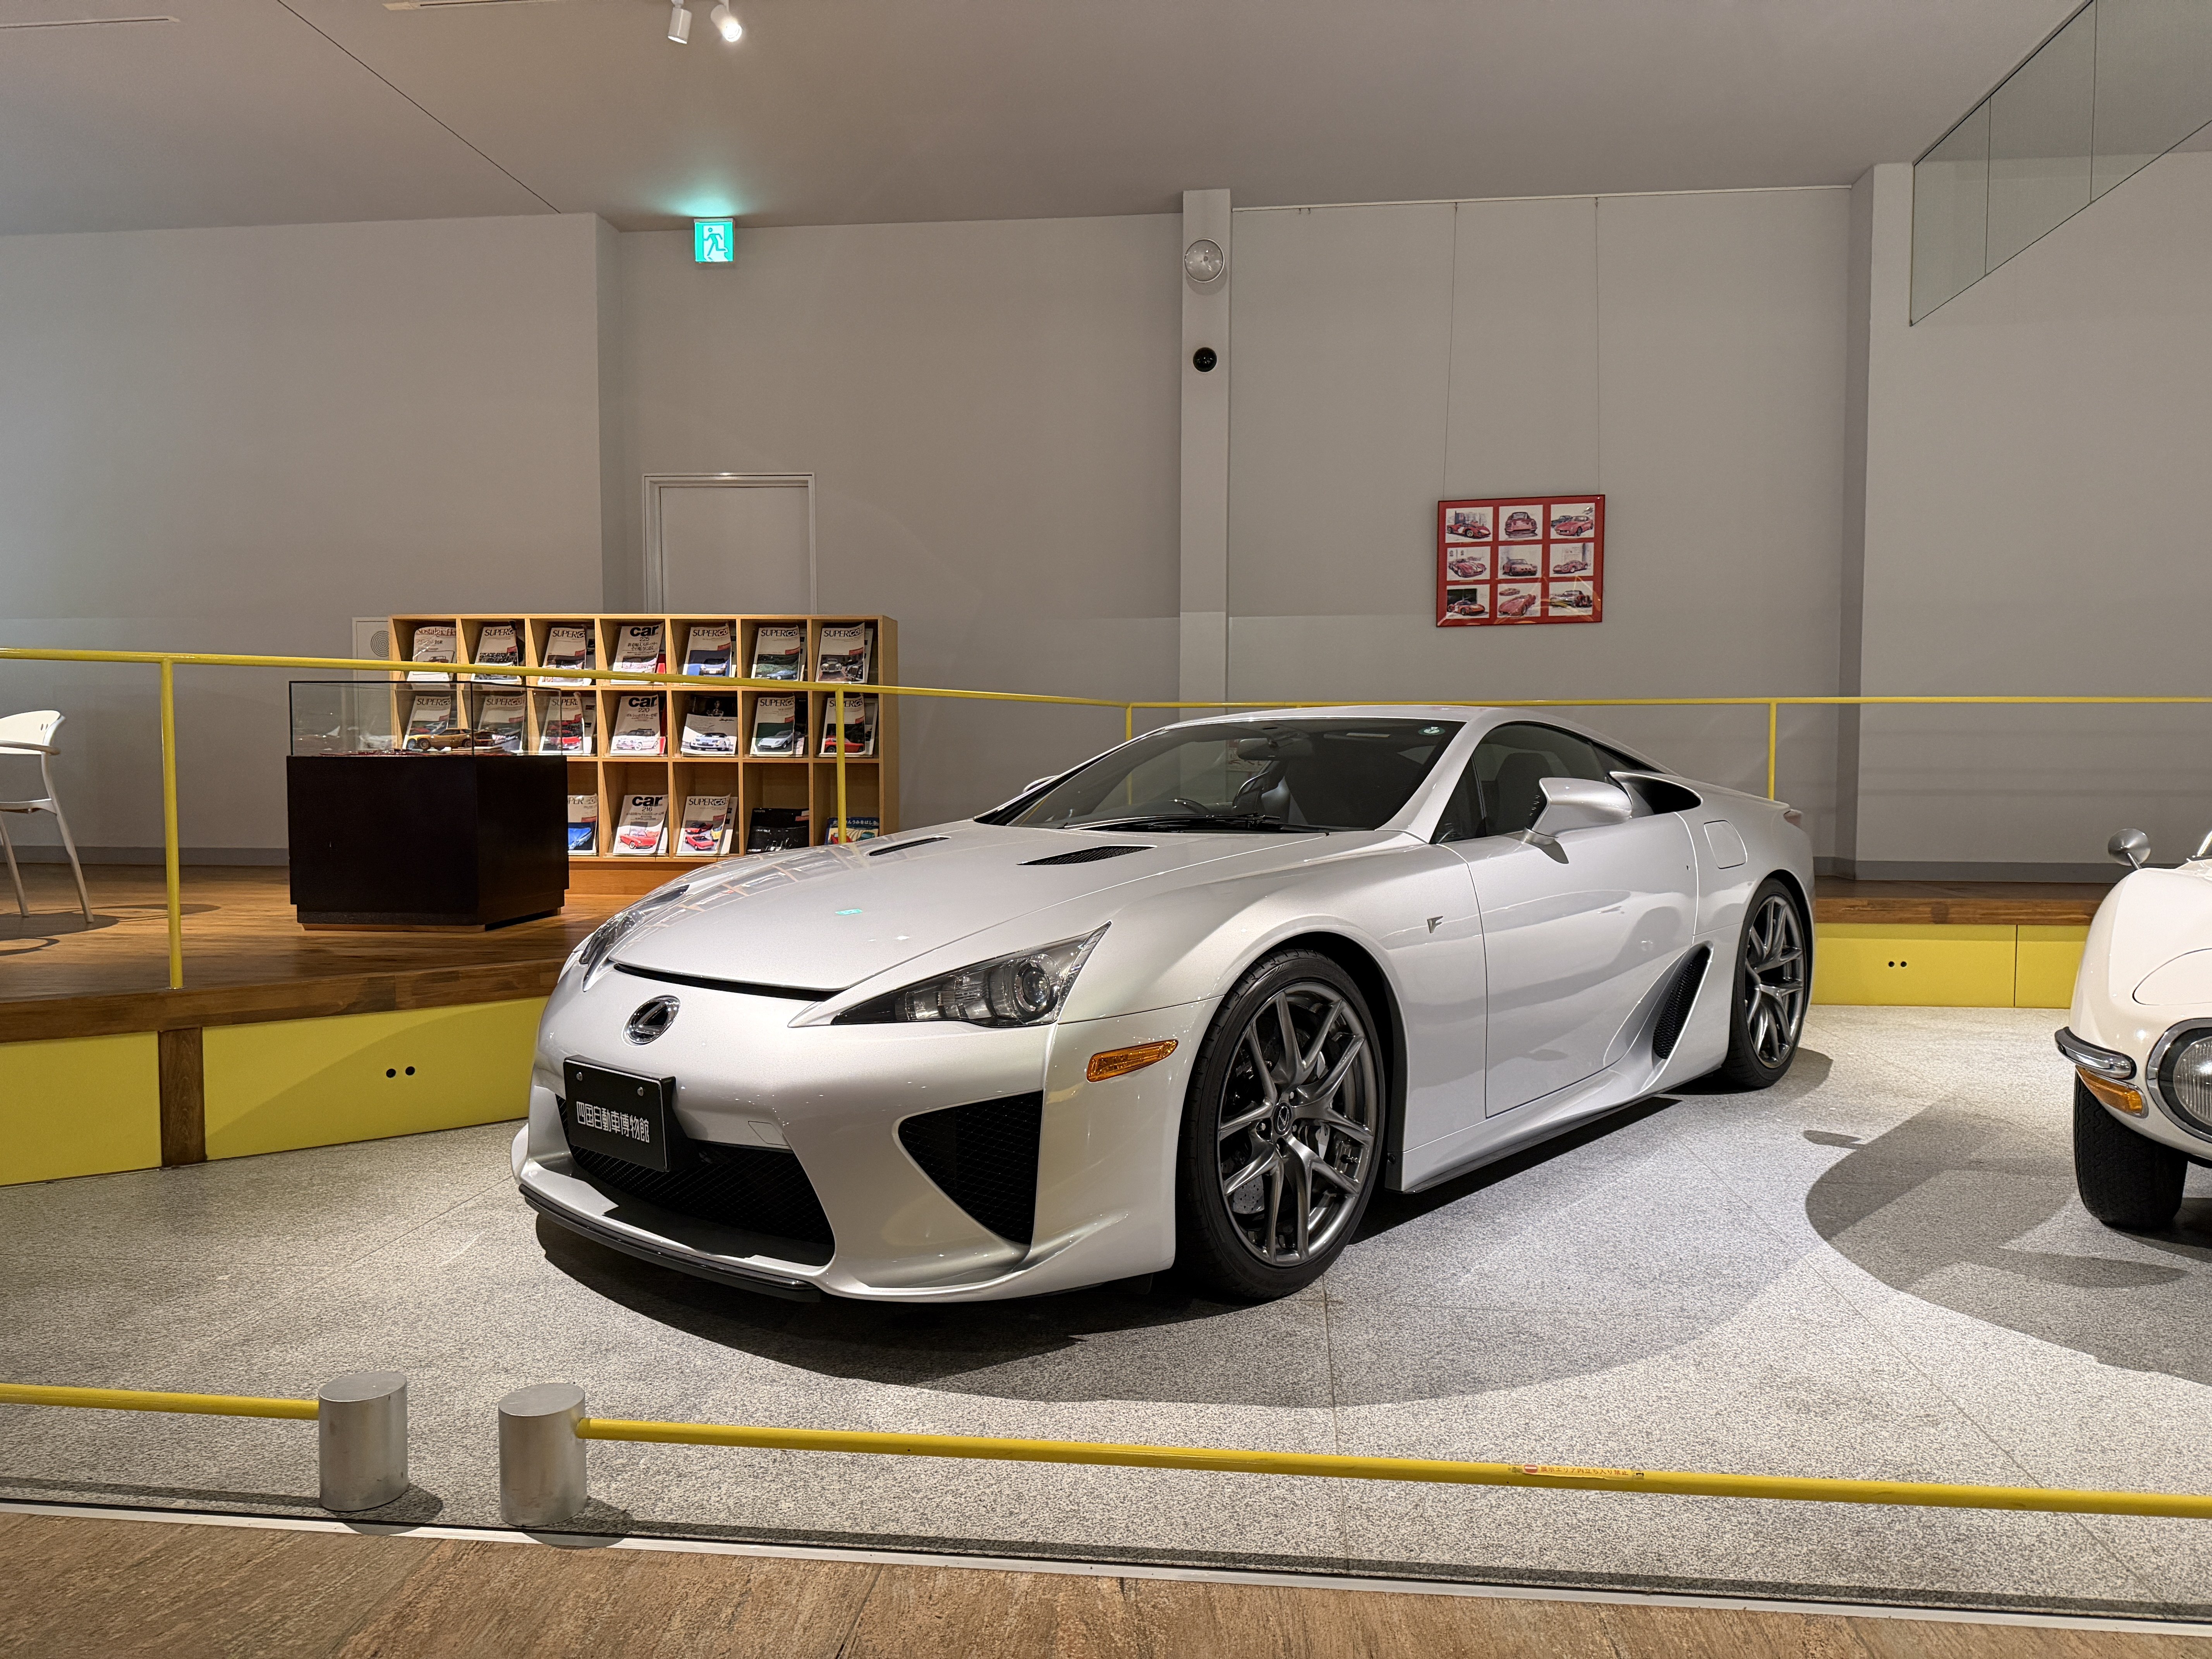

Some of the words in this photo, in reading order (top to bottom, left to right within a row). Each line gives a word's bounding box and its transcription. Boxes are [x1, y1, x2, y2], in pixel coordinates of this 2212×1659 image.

[630, 626, 659, 636] car
[628, 696, 657, 708] car
[632, 796, 663, 806] car
[576, 1101, 649, 1143] 四国自動車博物館
[1541, 1467, 1629, 1476] 展示エリア内立ち入り禁止
